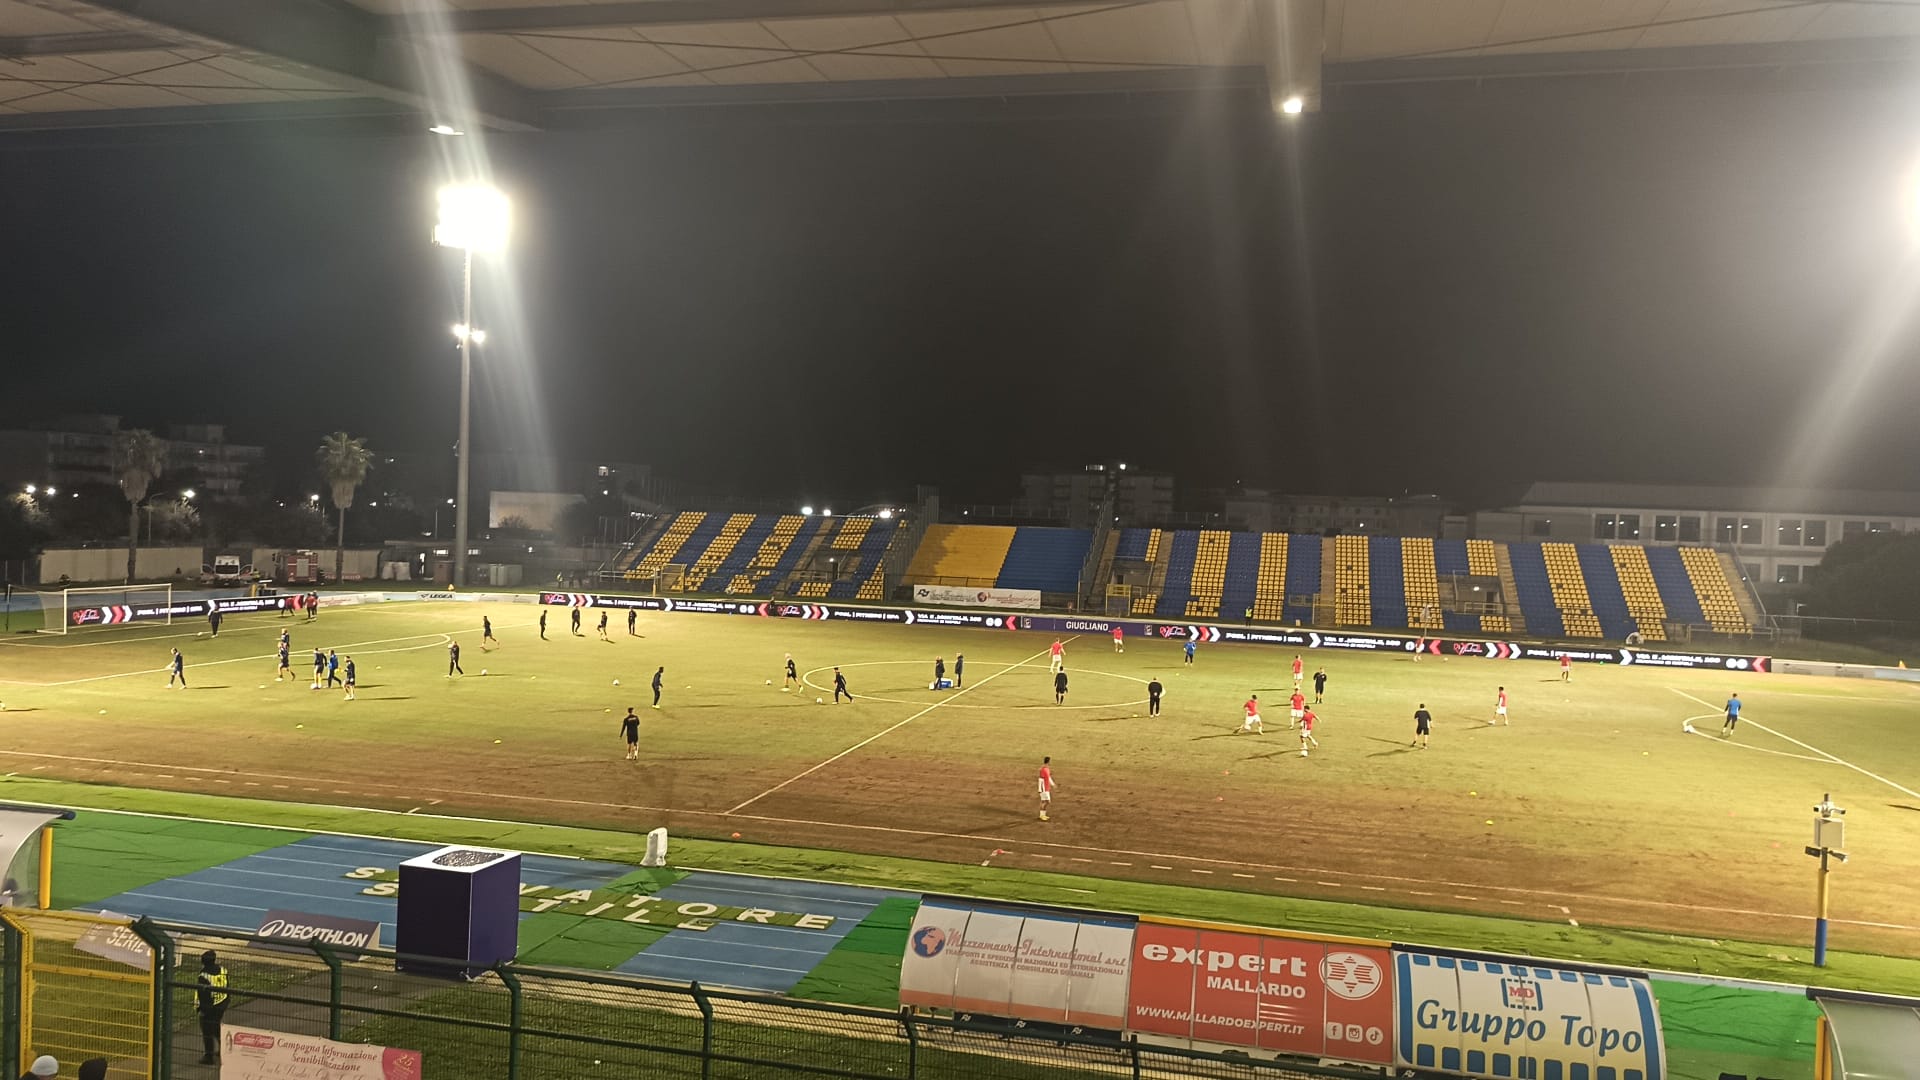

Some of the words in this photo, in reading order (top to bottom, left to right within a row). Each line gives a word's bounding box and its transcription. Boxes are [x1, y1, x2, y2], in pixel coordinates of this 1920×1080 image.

[1065, 621, 1109, 631] GIUGLIANO
[280, 923, 368, 948] DECATHLON
[1142, 943, 1307, 977] expert
[1206, 976, 1306, 999] MALLARDO
[1136, 1005, 1305, 1035] WWW.MALLARDOEXPERT.IT
[1416, 999, 1546, 1046] Gruppo
[1561, 1015, 1642, 1057] Topo
[277, 1038, 320, 1054] Campagna
[322, 1044, 377, 1060] Informazione
